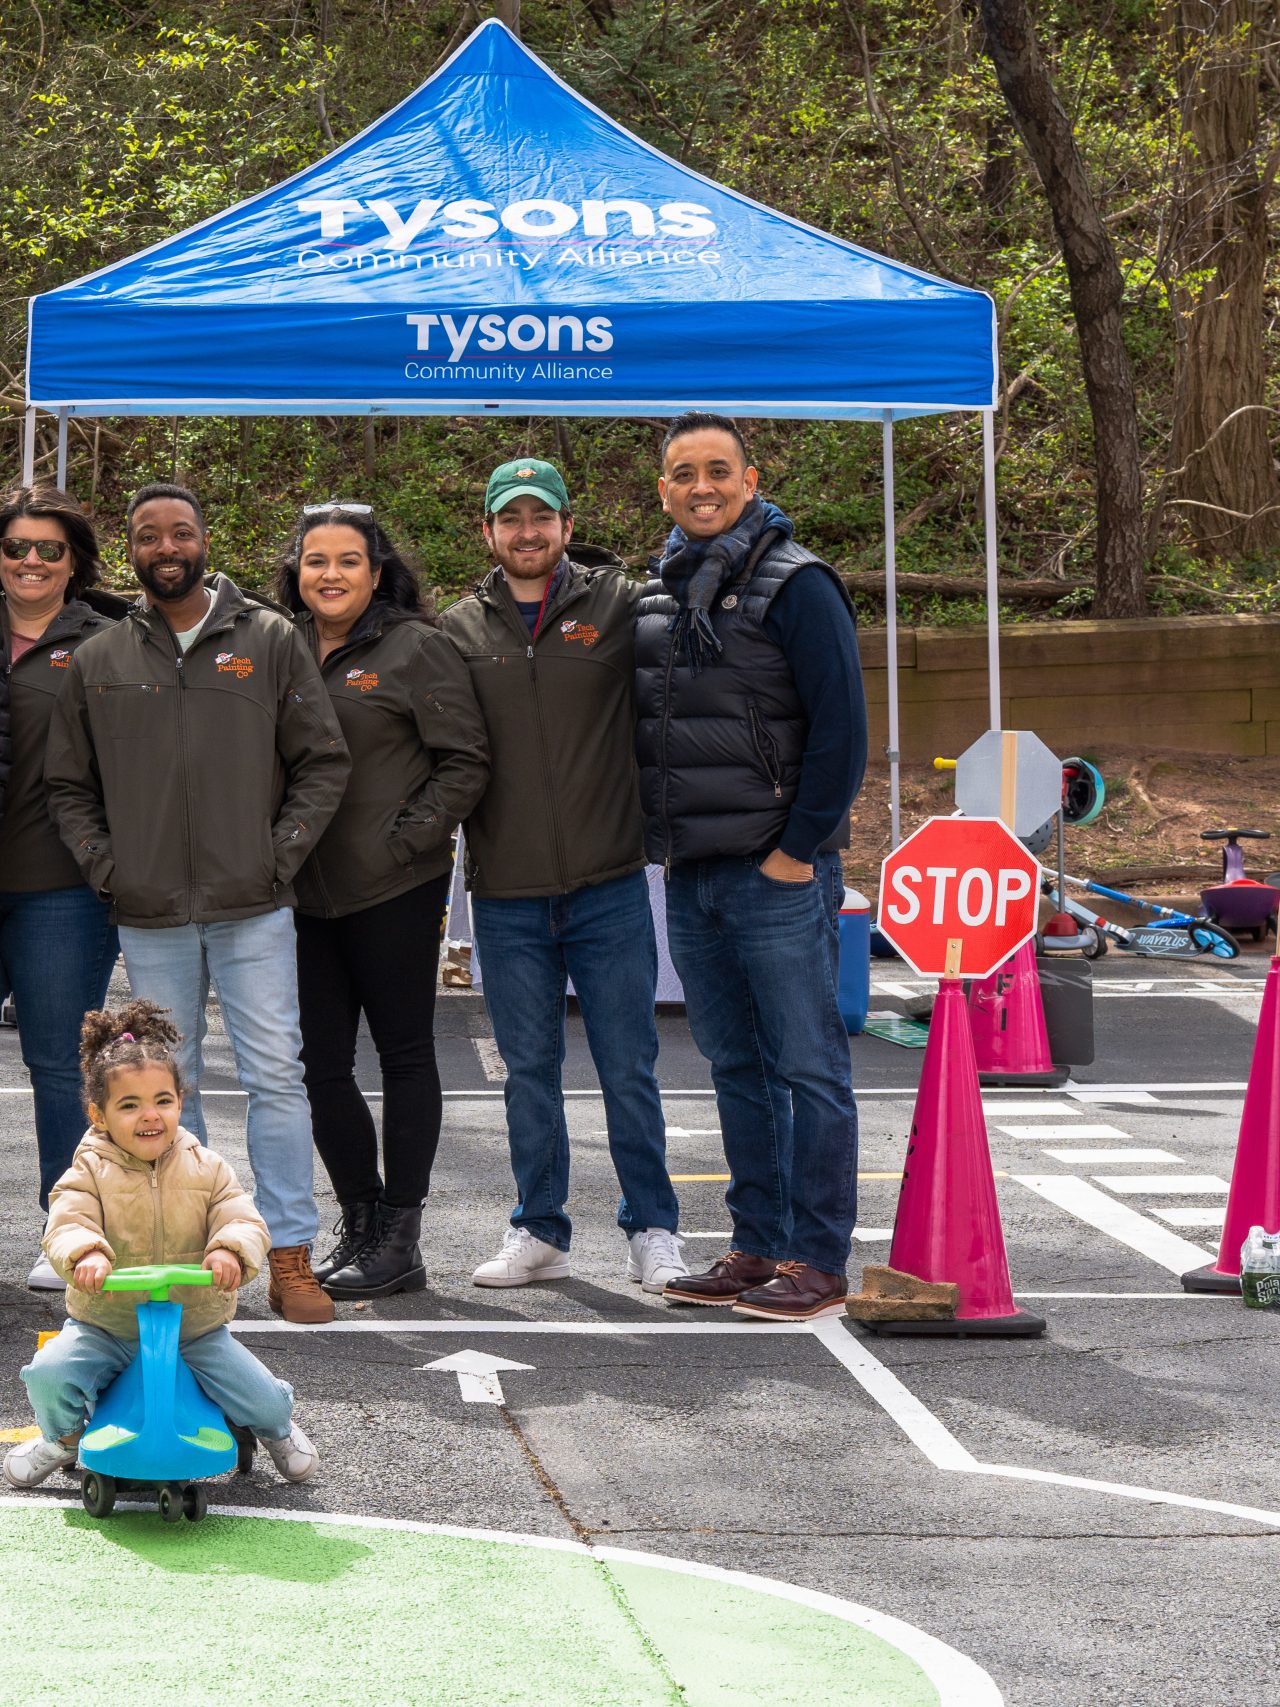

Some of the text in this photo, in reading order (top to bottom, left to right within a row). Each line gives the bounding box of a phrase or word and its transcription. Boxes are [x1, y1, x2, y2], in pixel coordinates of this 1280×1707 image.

[296, 198, 717, 251] Tysons
[297, 246, 720, 271] Community Alliance
[406, 313, 614, 362] Tysons
[404, 361, 613, 383] Community Alliance
[576, 623, 595, 631] Tech
[563, 630, 599, 641] Painting
[50, 660, 69, 668] Pain
[231, 657, 251, 665] Tech
[217, 664, 254, 673] Painting
[236, 670, 249, 678] Co
[360, 672, 378, 680] Tech
[346, 679, 379, 687] Painting
[887, 866, 1031, 927] STOP
[1137, 934, 1189, 947] WAYPLUS
[996, 954, 1016, 1032] FI
[1256, 1279, 1280, 1292] Pola
[1257, 1287, 1280, 1303] Spri
